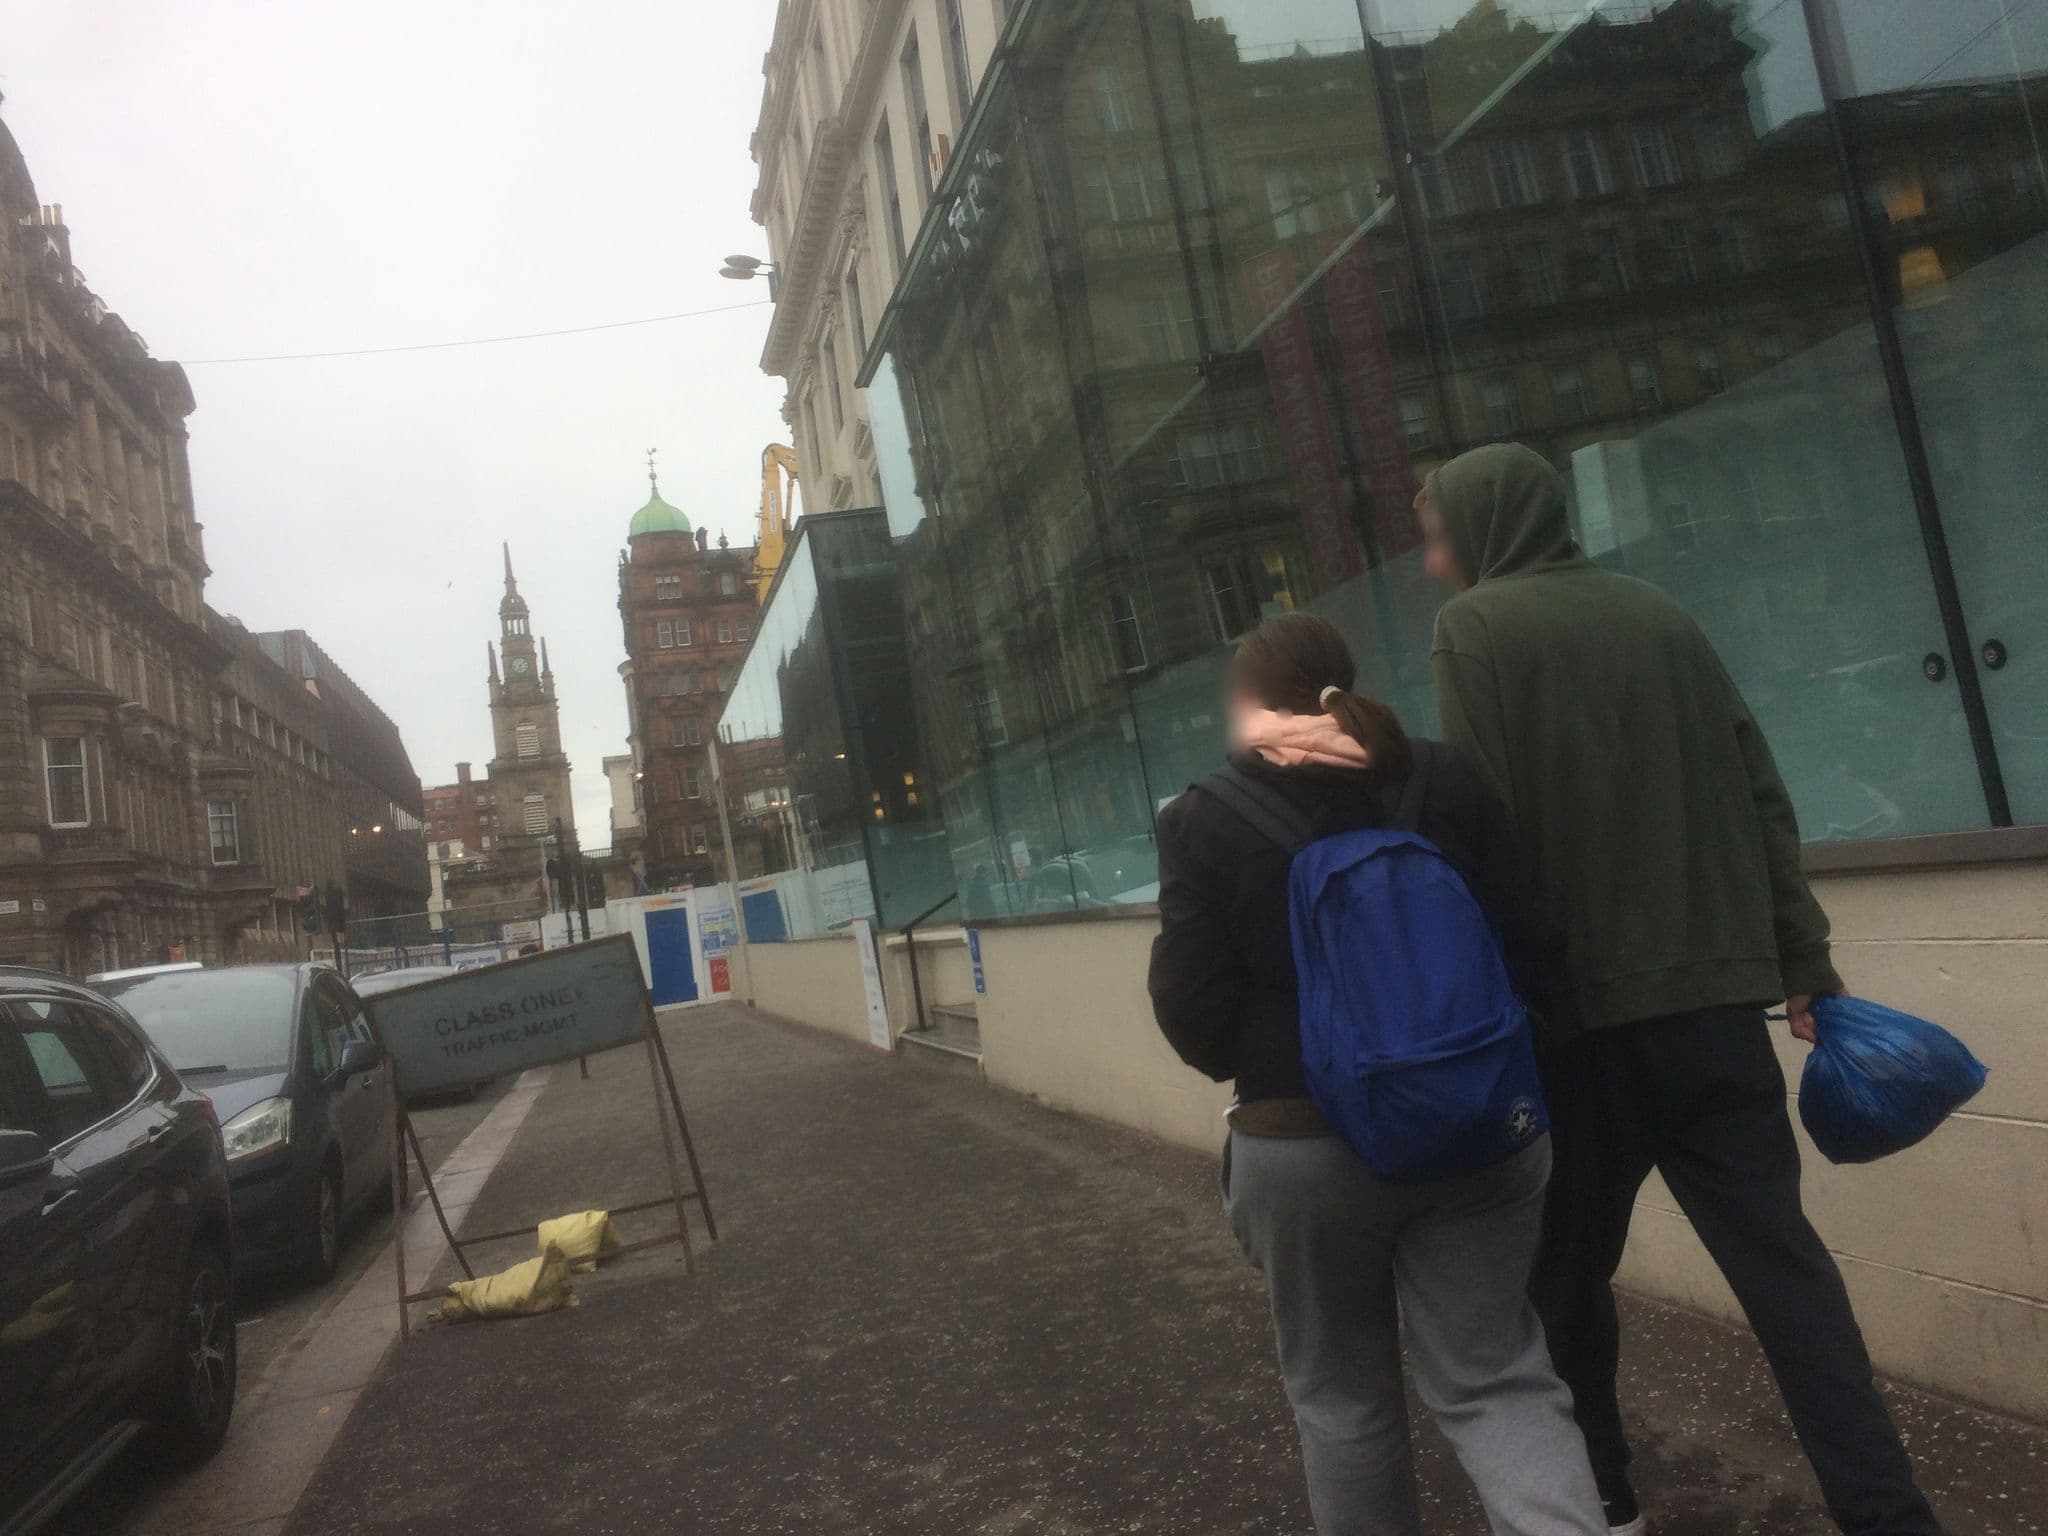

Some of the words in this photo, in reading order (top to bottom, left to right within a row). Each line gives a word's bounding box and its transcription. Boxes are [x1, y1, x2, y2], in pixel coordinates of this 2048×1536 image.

[434, 1001, 515, 1037] CLASS
[440, 1028, 520, 1057] TRAFFIC
[523, 1011, 579, 1037] MGMT
